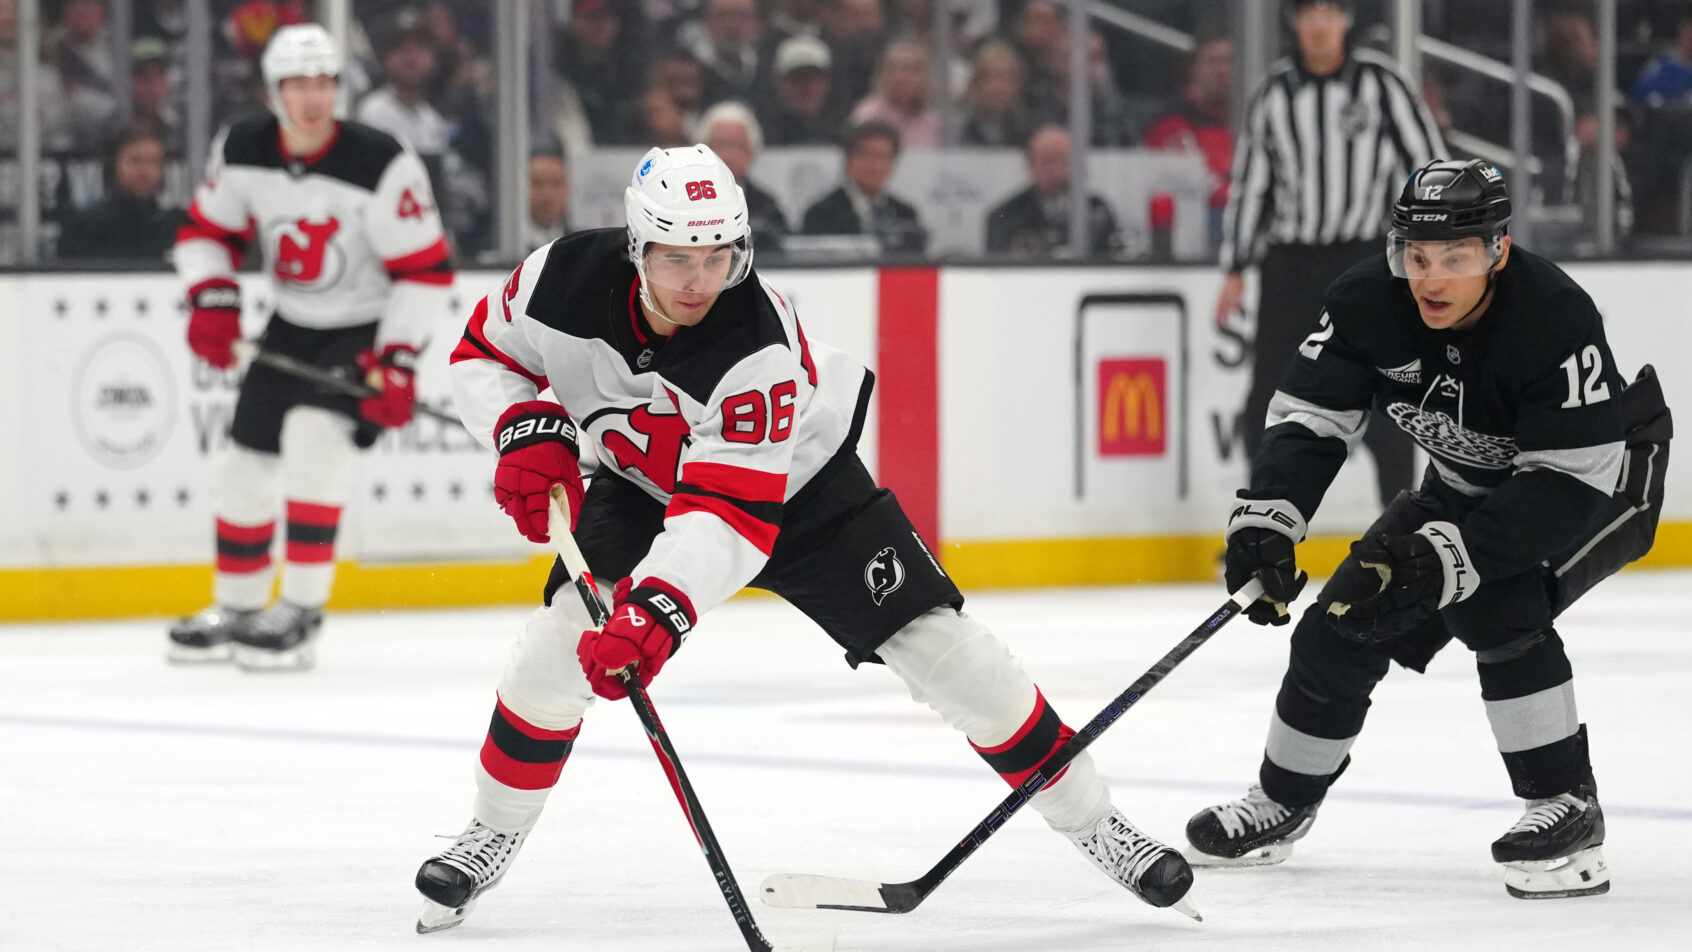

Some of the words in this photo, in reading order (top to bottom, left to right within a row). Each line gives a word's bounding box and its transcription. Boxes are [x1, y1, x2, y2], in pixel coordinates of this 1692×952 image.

[685, 180, 717, 201] 86
[1422, 185, 1444, 200] 12
[687, 218, 725, 227] BAUER
[1411, 214, 1448, 222] CCM
[1559, 344, 1611, 409] 12
[721, 379, 797, 445] 86
[1228, 504, 1297, 530] RUE
[716, 871, 746, 924] FLYLITE
